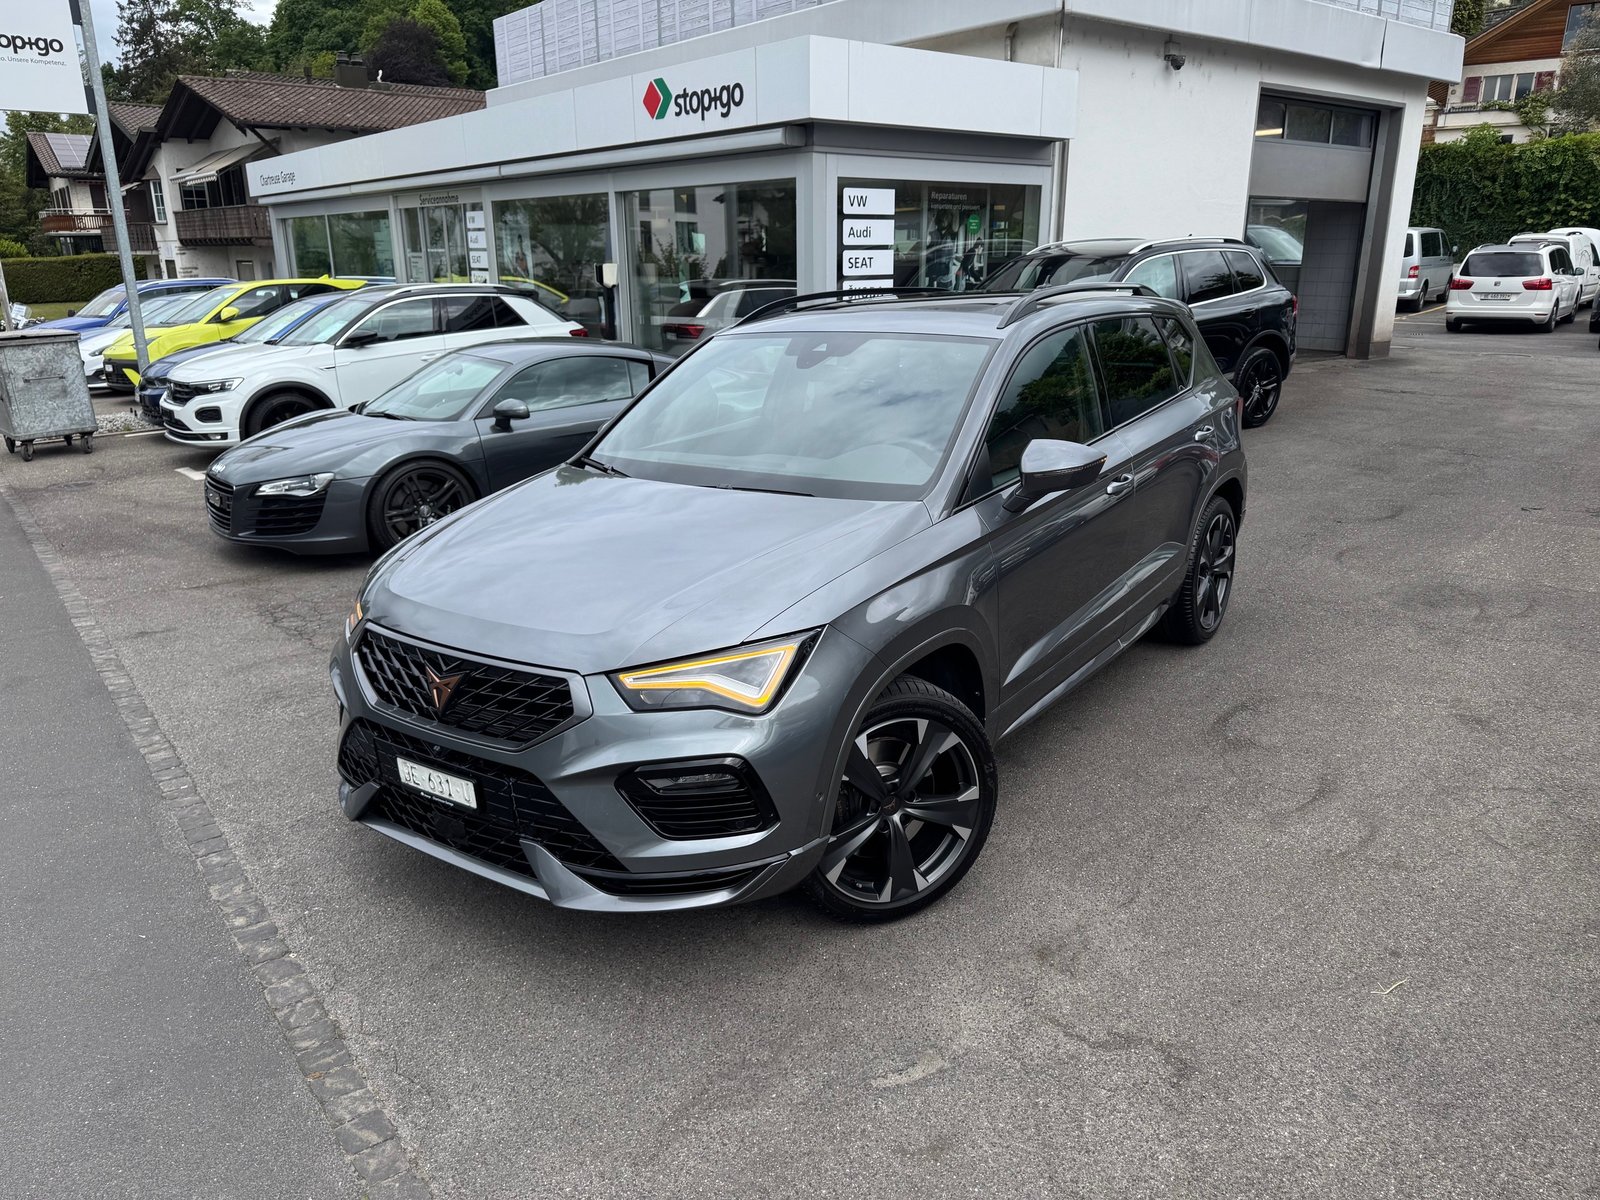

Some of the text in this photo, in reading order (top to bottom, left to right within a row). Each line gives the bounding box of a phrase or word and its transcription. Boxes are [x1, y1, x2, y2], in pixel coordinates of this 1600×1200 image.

[7, 56, 30, 64] Unsere
[674, 82, 744, 121] stop+go
[280, 170, 296, 185] Garage
[848, 195, 868, 208] VW
[931, 191, 968, 201] Reparaturen
[847, 226, 872, 239] Audi
[471, 255, 482, 265] SEAT
[847, 256, 874, 269] SEAT
[428, 771, 455, 798] 631
